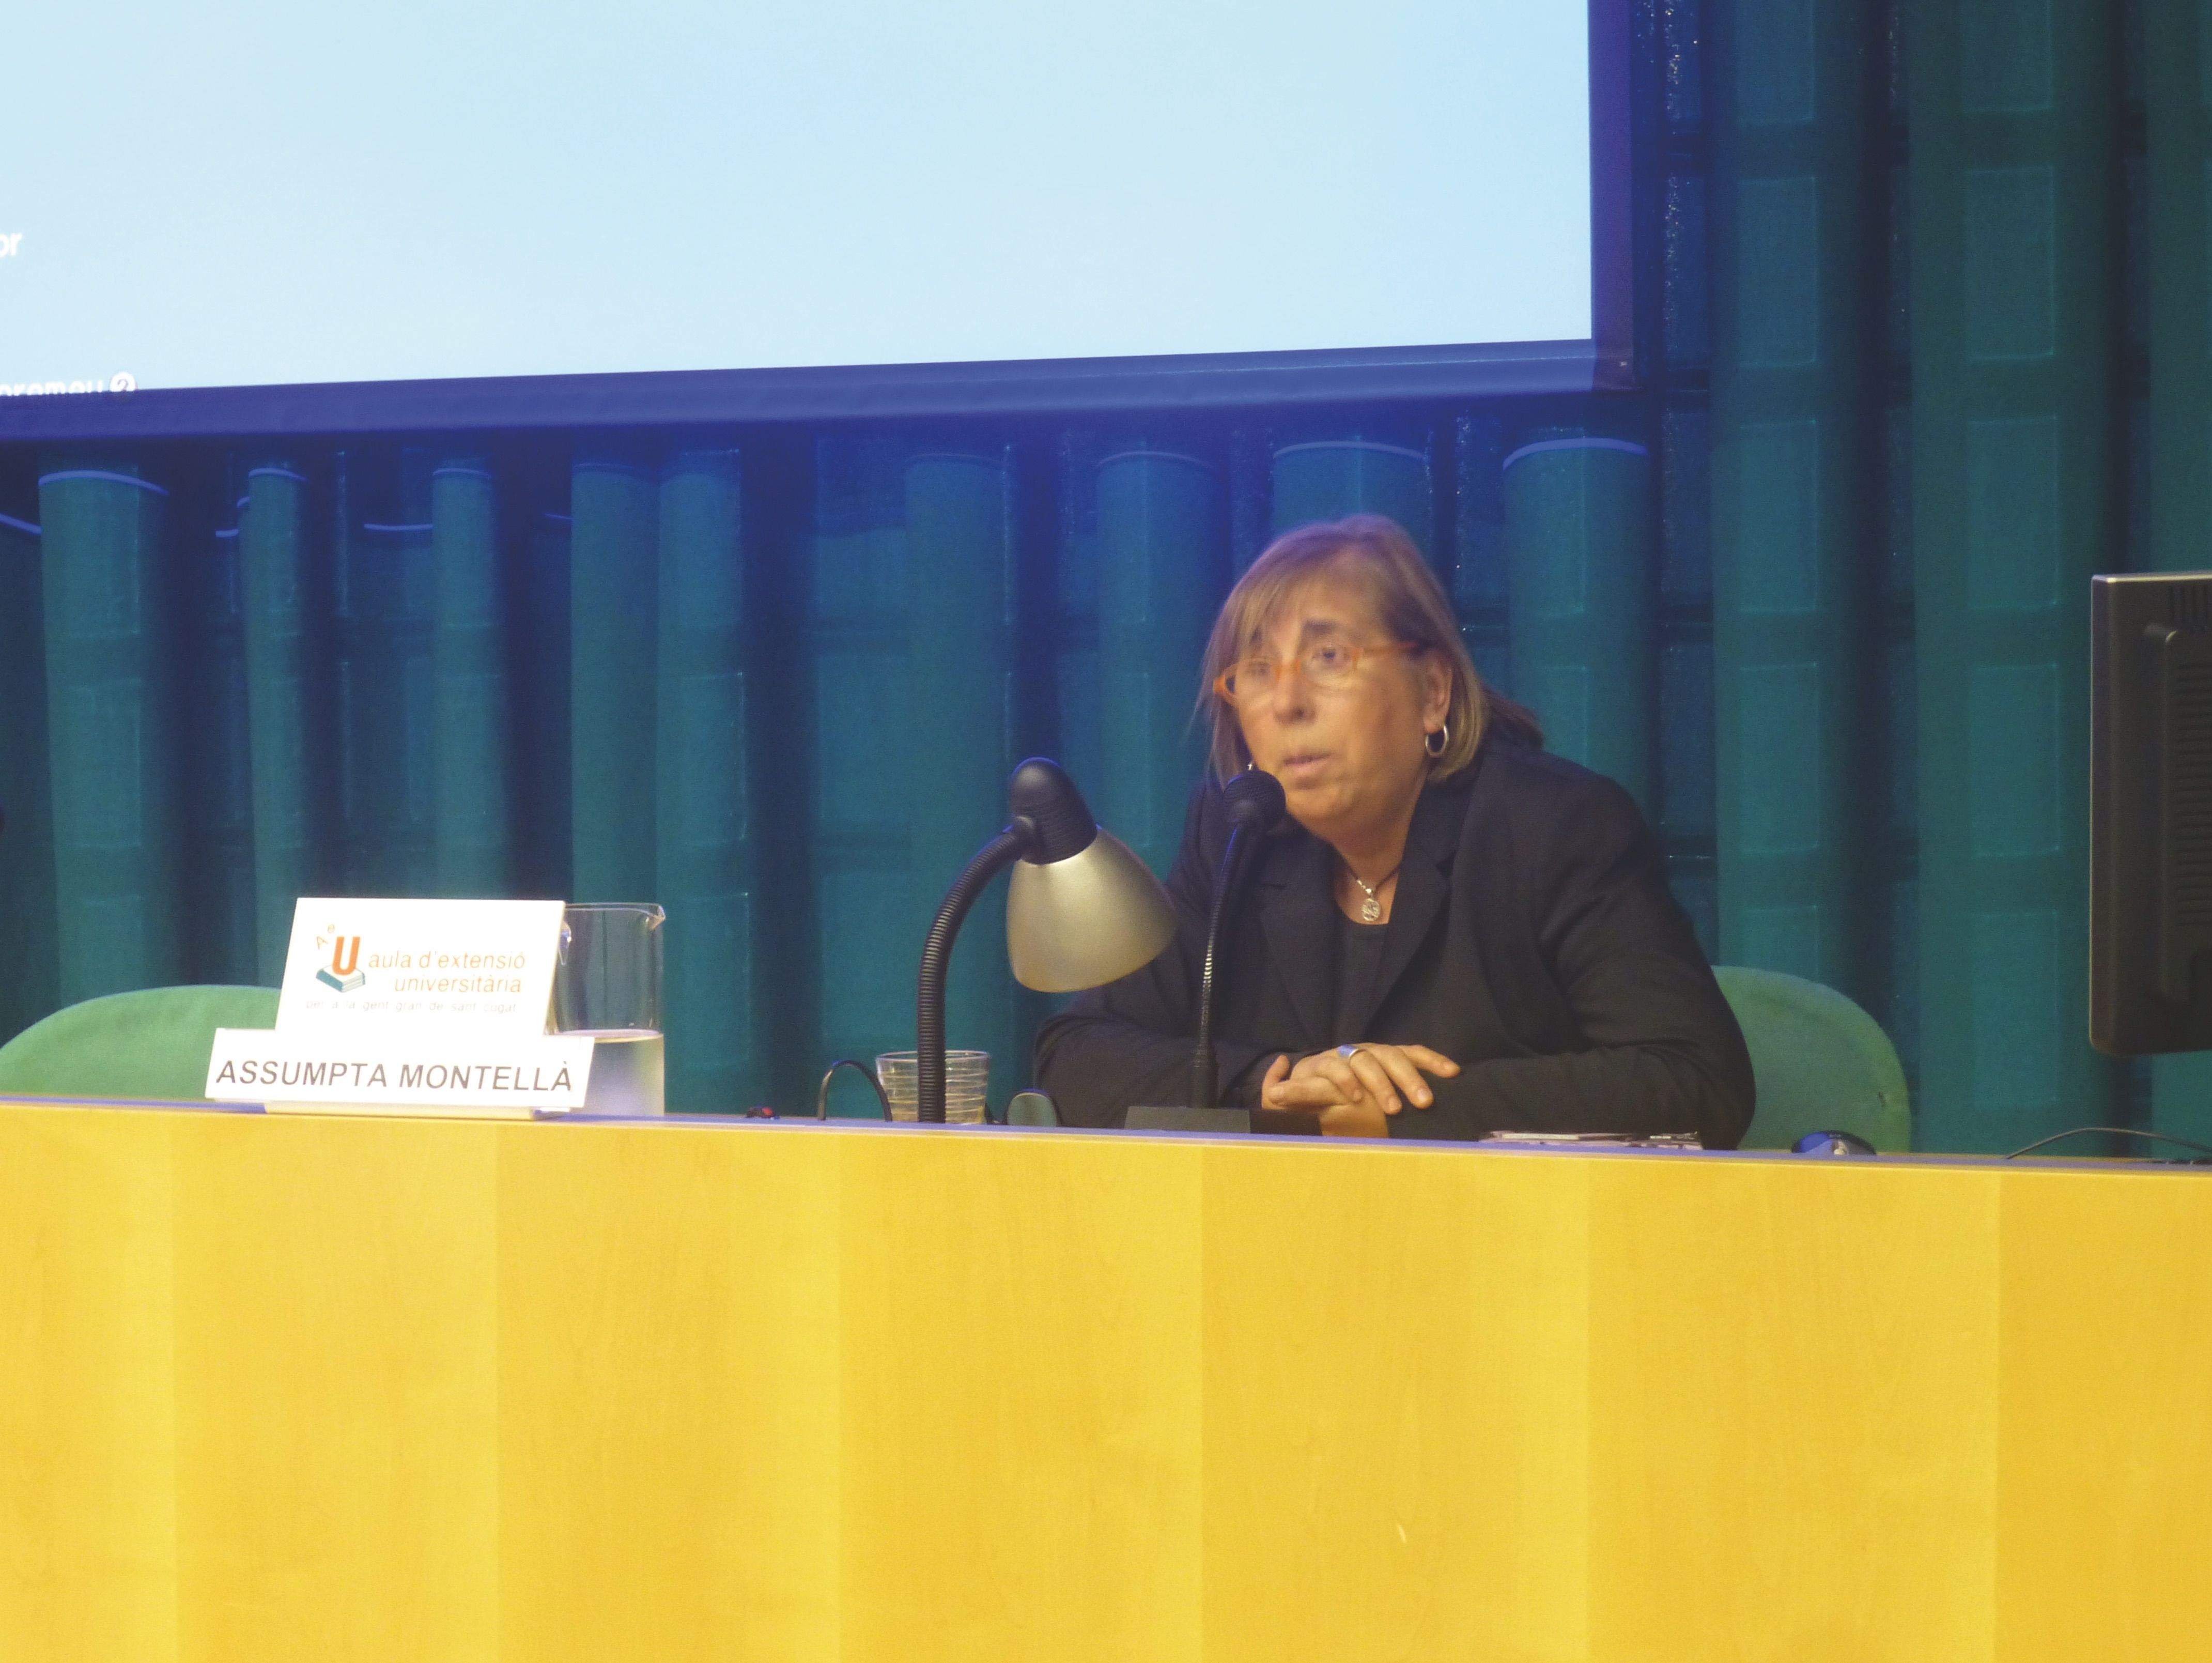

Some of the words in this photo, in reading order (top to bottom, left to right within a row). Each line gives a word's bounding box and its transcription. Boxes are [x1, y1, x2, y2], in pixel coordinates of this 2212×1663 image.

[368, 950, 411, 969] aula
[419, 950, 525, 970] d'extensió
[394, 975, 522, 993] universitària
[215, 1060, 388, 1088] ASSUMPTA
[399, 1060, 572, 1091] MONTELLÀ
